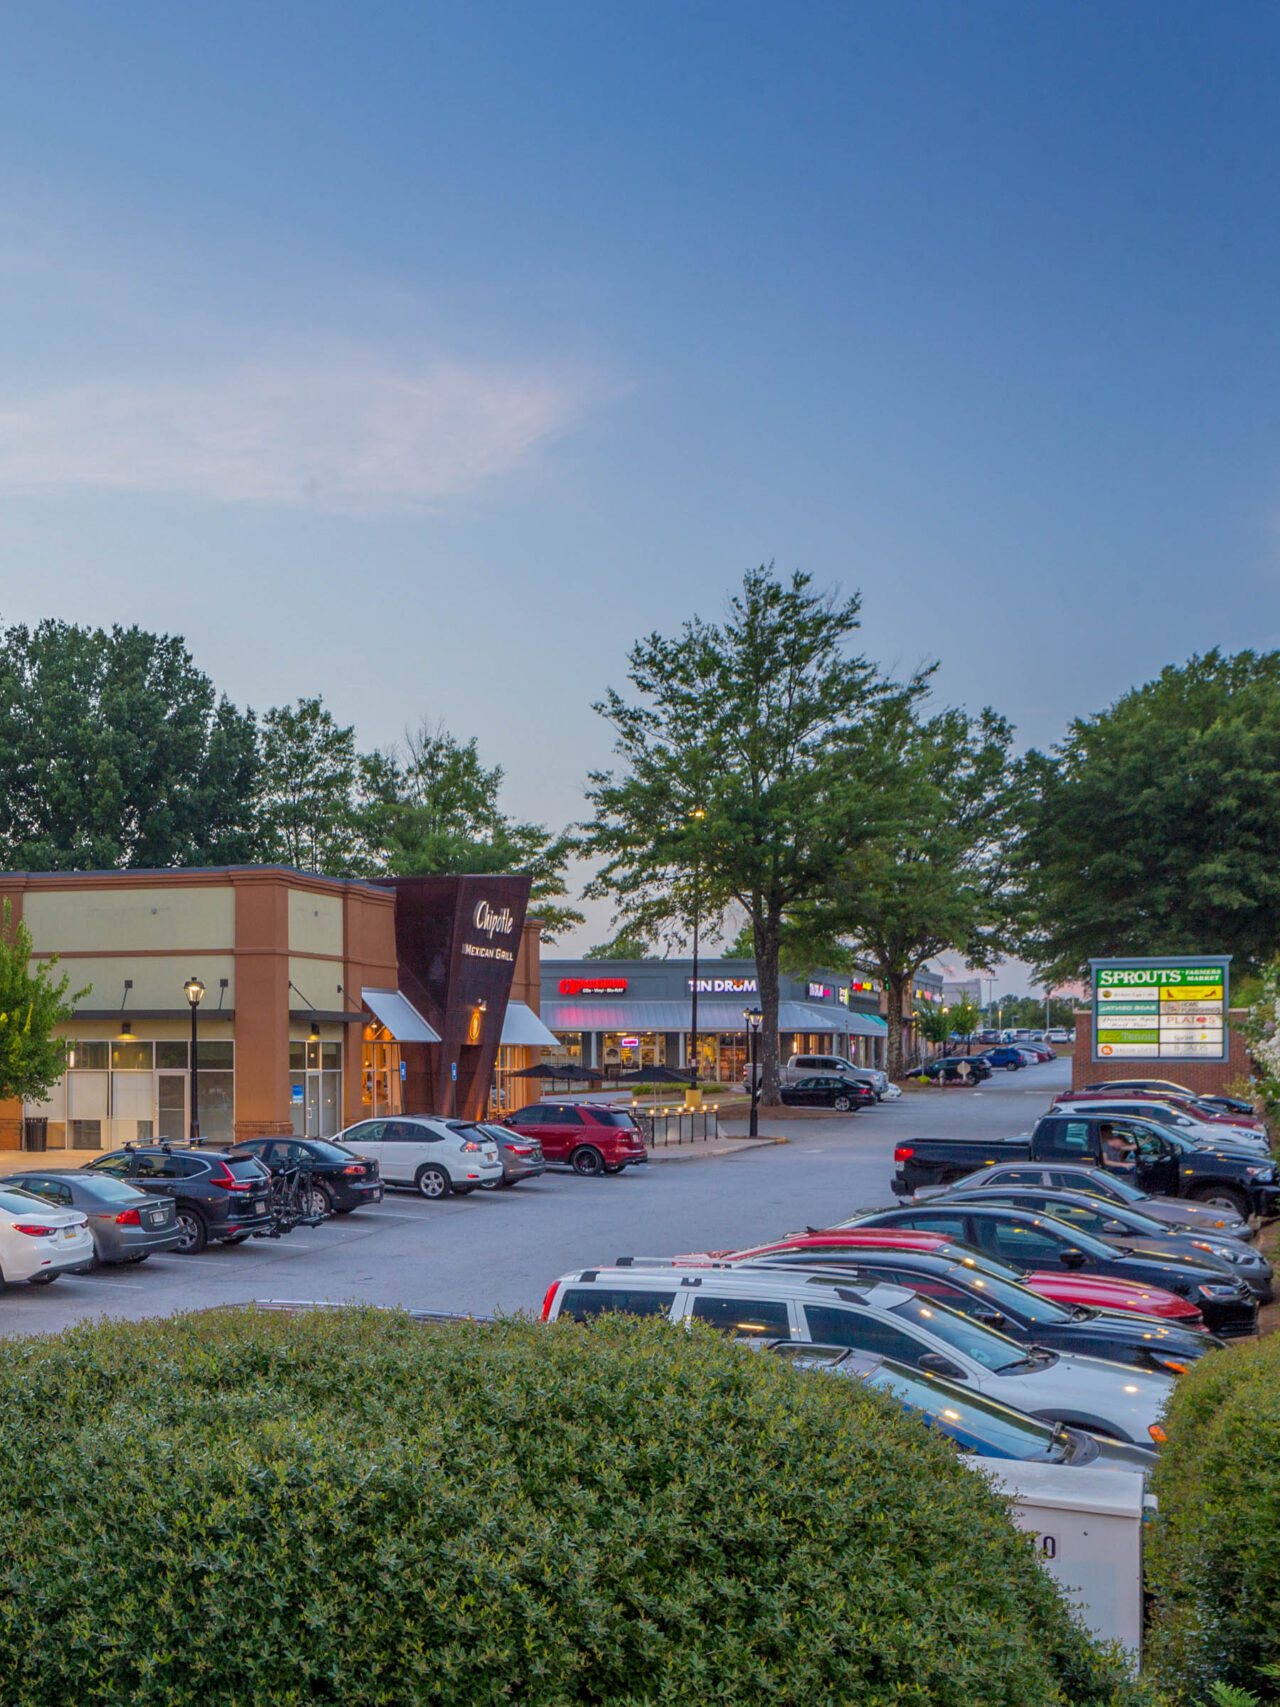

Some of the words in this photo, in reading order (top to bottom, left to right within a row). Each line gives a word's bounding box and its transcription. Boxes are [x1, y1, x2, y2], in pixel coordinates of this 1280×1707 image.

[475, 900, 514, 940] Chipotle
[1100, 970, 1182, 985] SPROUTS
[688, 979, 712, 992] TIN
